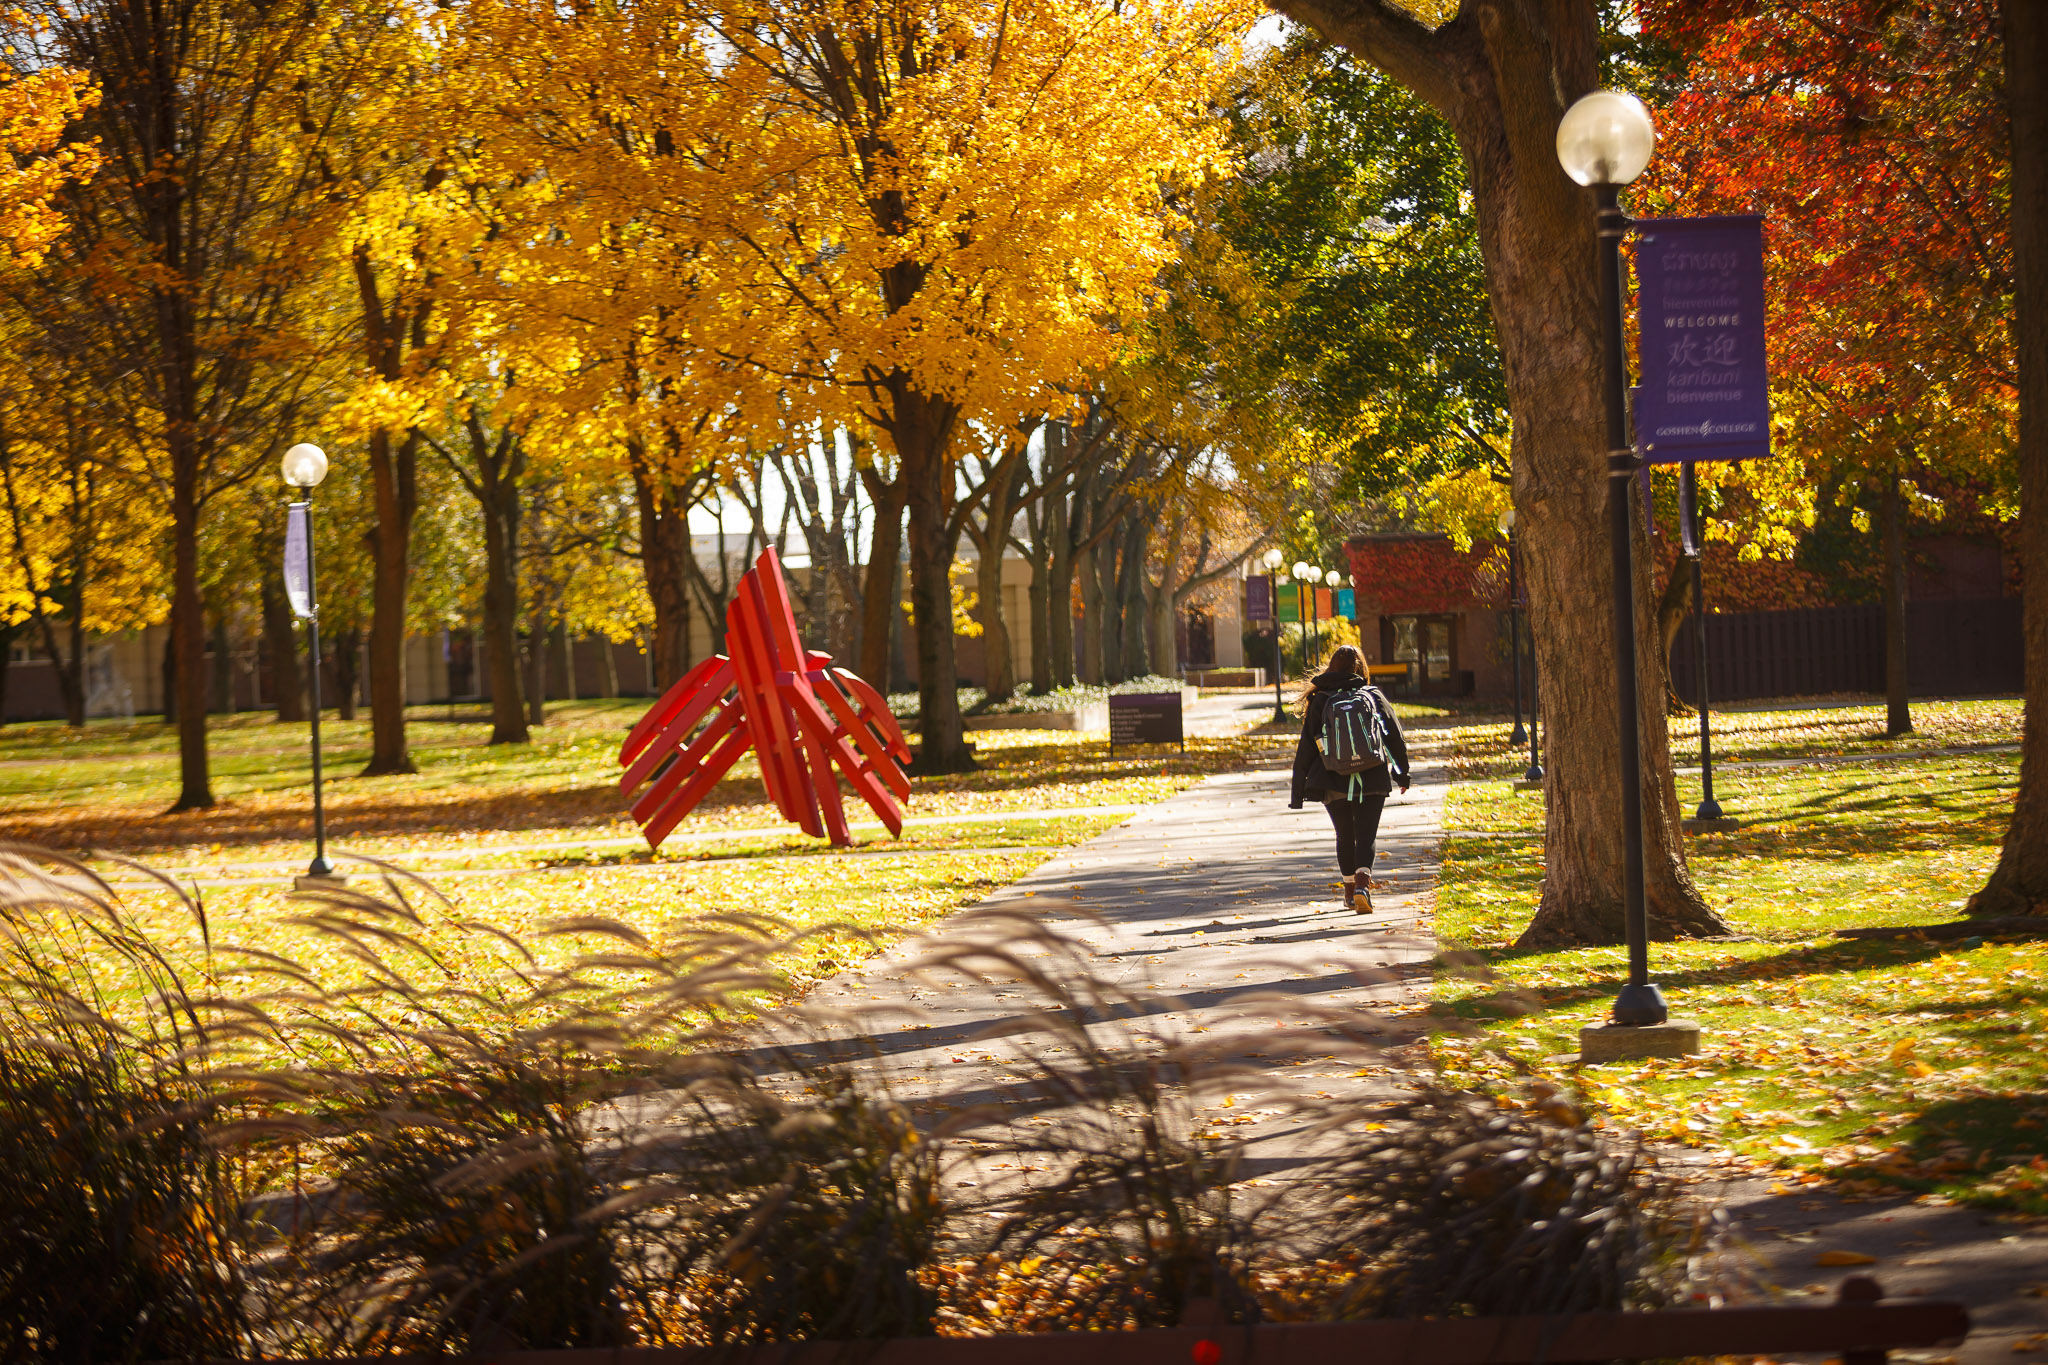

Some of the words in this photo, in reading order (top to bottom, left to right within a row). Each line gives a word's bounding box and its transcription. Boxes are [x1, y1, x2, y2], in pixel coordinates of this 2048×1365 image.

[1664, 314, 1740, 328] WELCOME
[1665, 333, 1742, 366] 欢迎
[1667, 368, 1741, 385] karibuni
[1667, 389, 1743, 404] bienvenue
[1656, 425, 1699, 437] GOSHEN
[1708, 422, 1757, 434] COLLEGE
